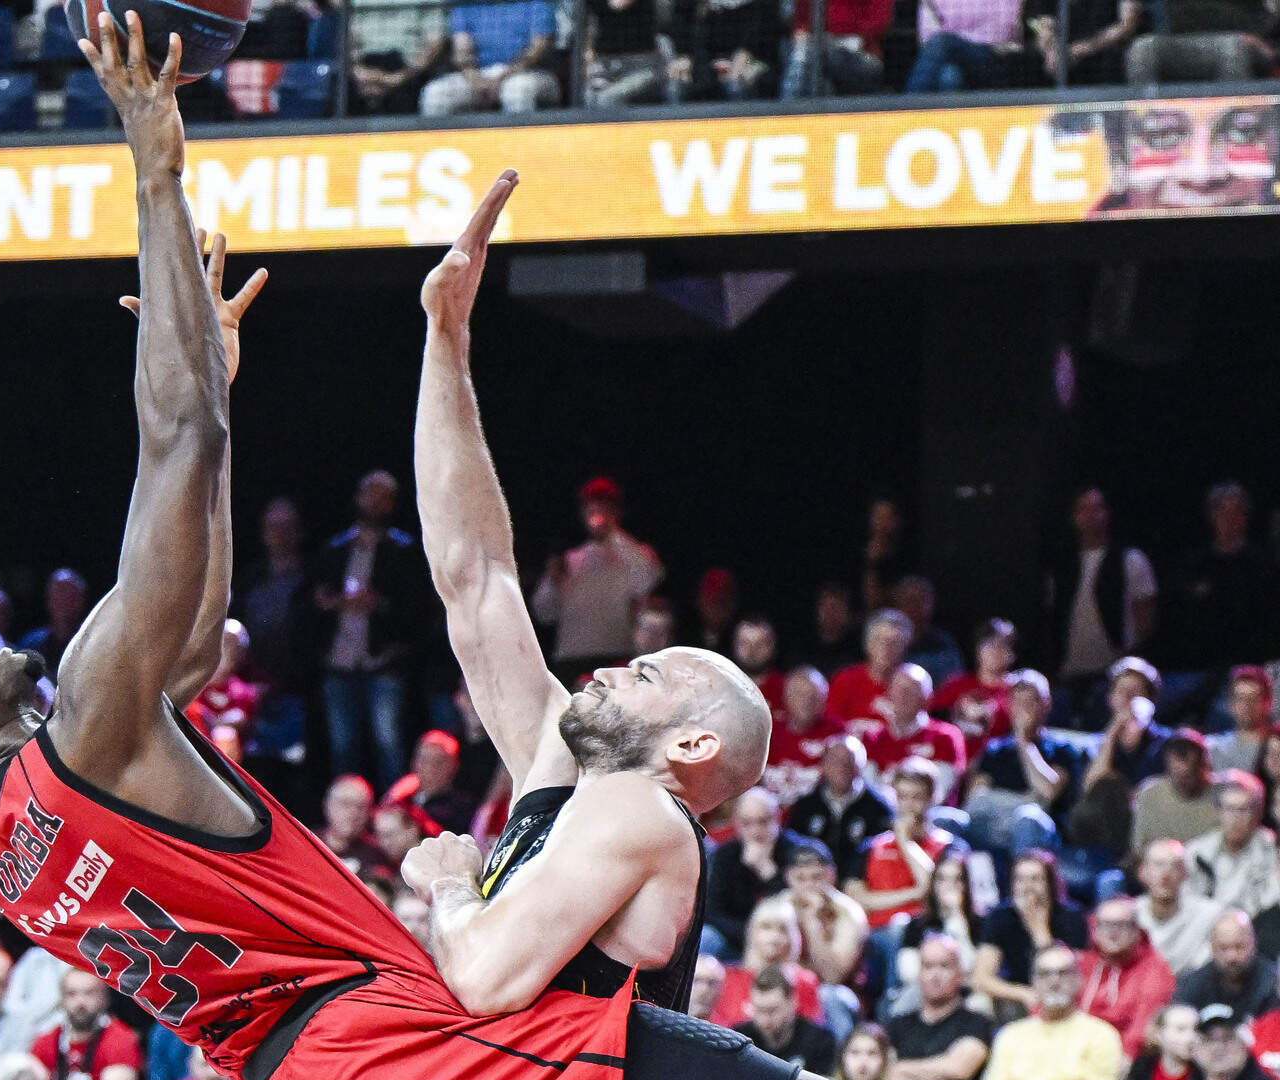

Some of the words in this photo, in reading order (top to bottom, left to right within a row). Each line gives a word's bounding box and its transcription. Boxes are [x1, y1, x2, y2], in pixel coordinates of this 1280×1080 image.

[650, 134, 806, 218] WE
[834, 125, 1089, 212] LOVE
[73, 852, 109, 892] Daily
[77, 887, 244, 1028] 24
